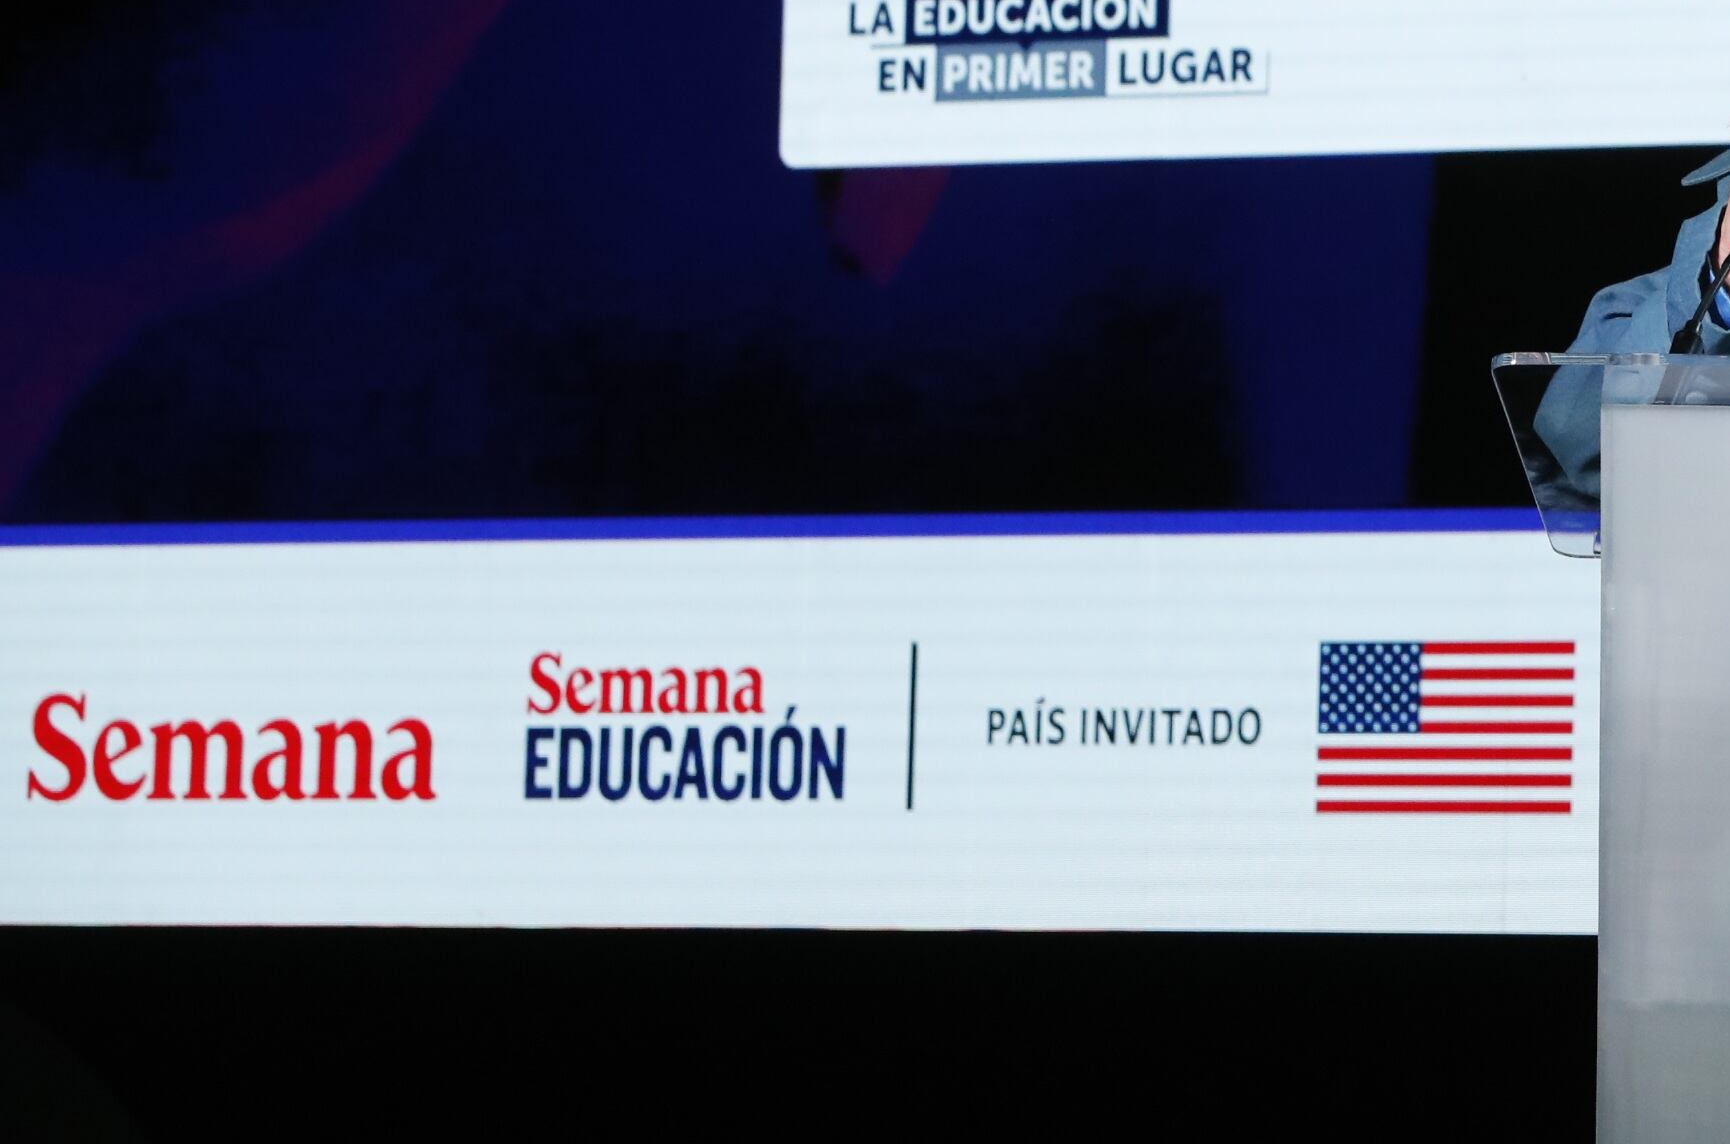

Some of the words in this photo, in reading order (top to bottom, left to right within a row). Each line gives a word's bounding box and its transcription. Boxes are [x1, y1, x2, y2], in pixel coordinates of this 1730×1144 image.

[849, 1, 895, 37] LA
[878, 58, 927, 93] EN
[942, 50, 1095, 93] PRIMER
[1118, 48, 1253, 86] LUGAR
[526, 651, 765, 714] Semana
[27, 692, 437, 803] Semana
[987, 698, 1066, 745] PAÍS
[1080, 707, 1263, 746] INVITADO
[524, 706, 846, 802] EDUCACIÓN
